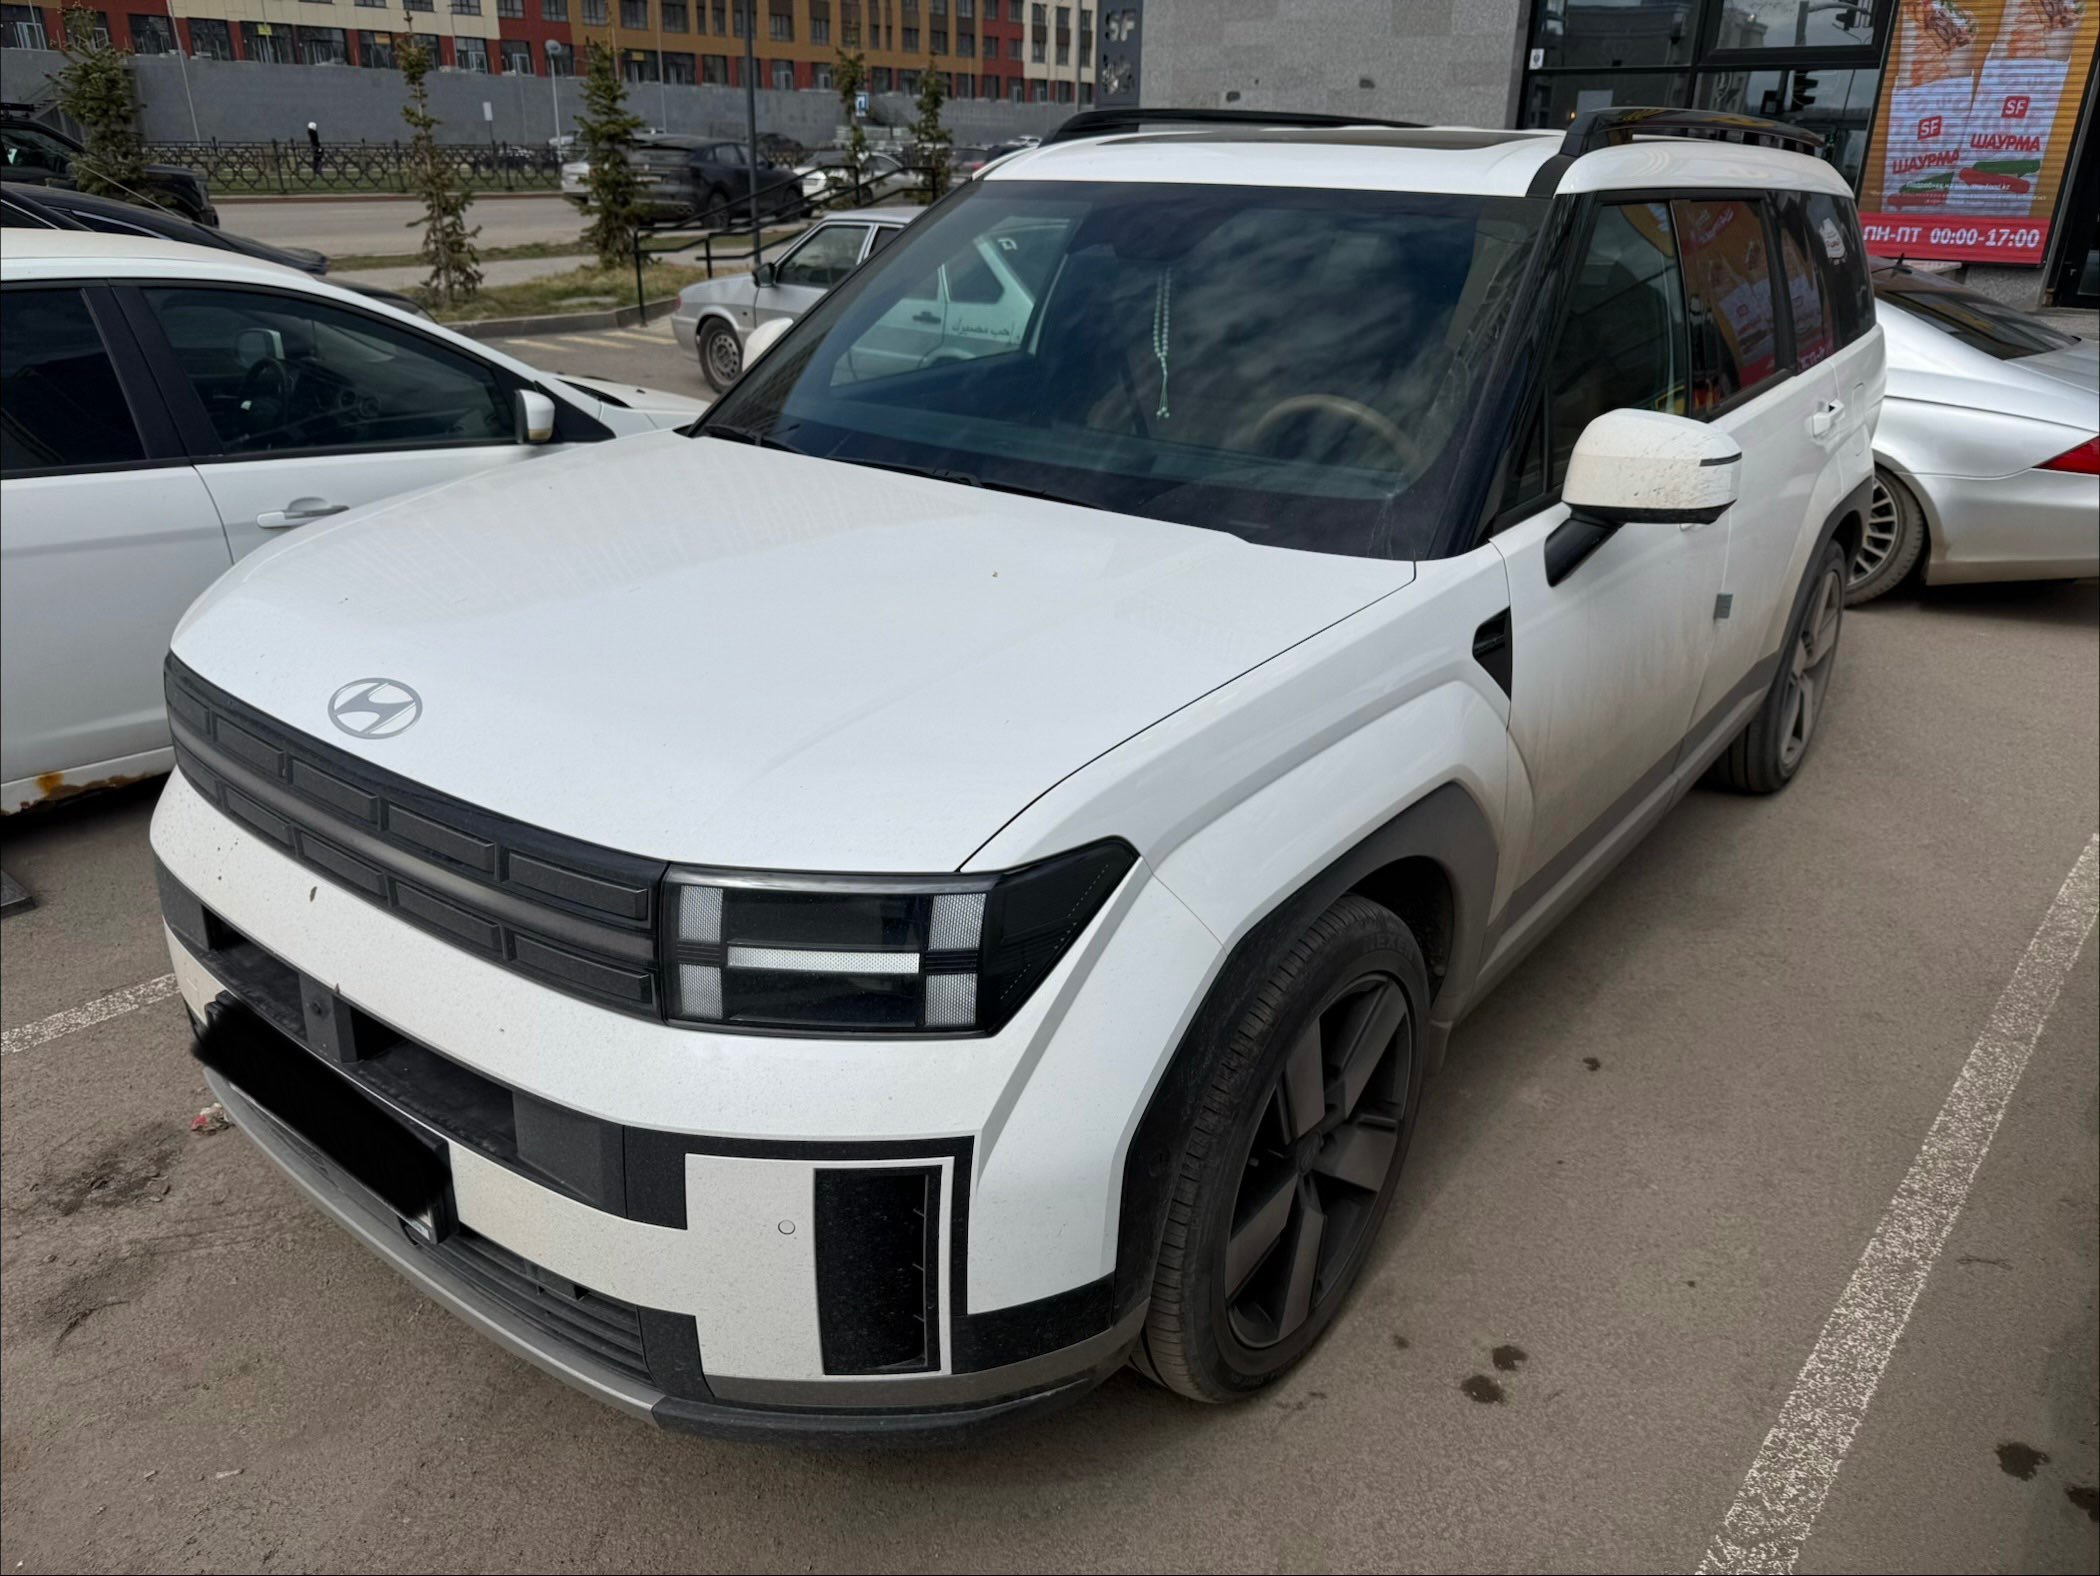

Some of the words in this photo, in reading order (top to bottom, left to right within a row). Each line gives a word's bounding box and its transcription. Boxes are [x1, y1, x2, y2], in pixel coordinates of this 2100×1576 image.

[1920, 120, 1939, 136] SF
[1970, 133, 2041, 152] ШАУРМА
[1892, 149, 1960, 174] ШАУРМА
[1863, 225, 1922, 243] ПН-ПТ
[1929, 228, 2040, 248] 00:00-17:00
